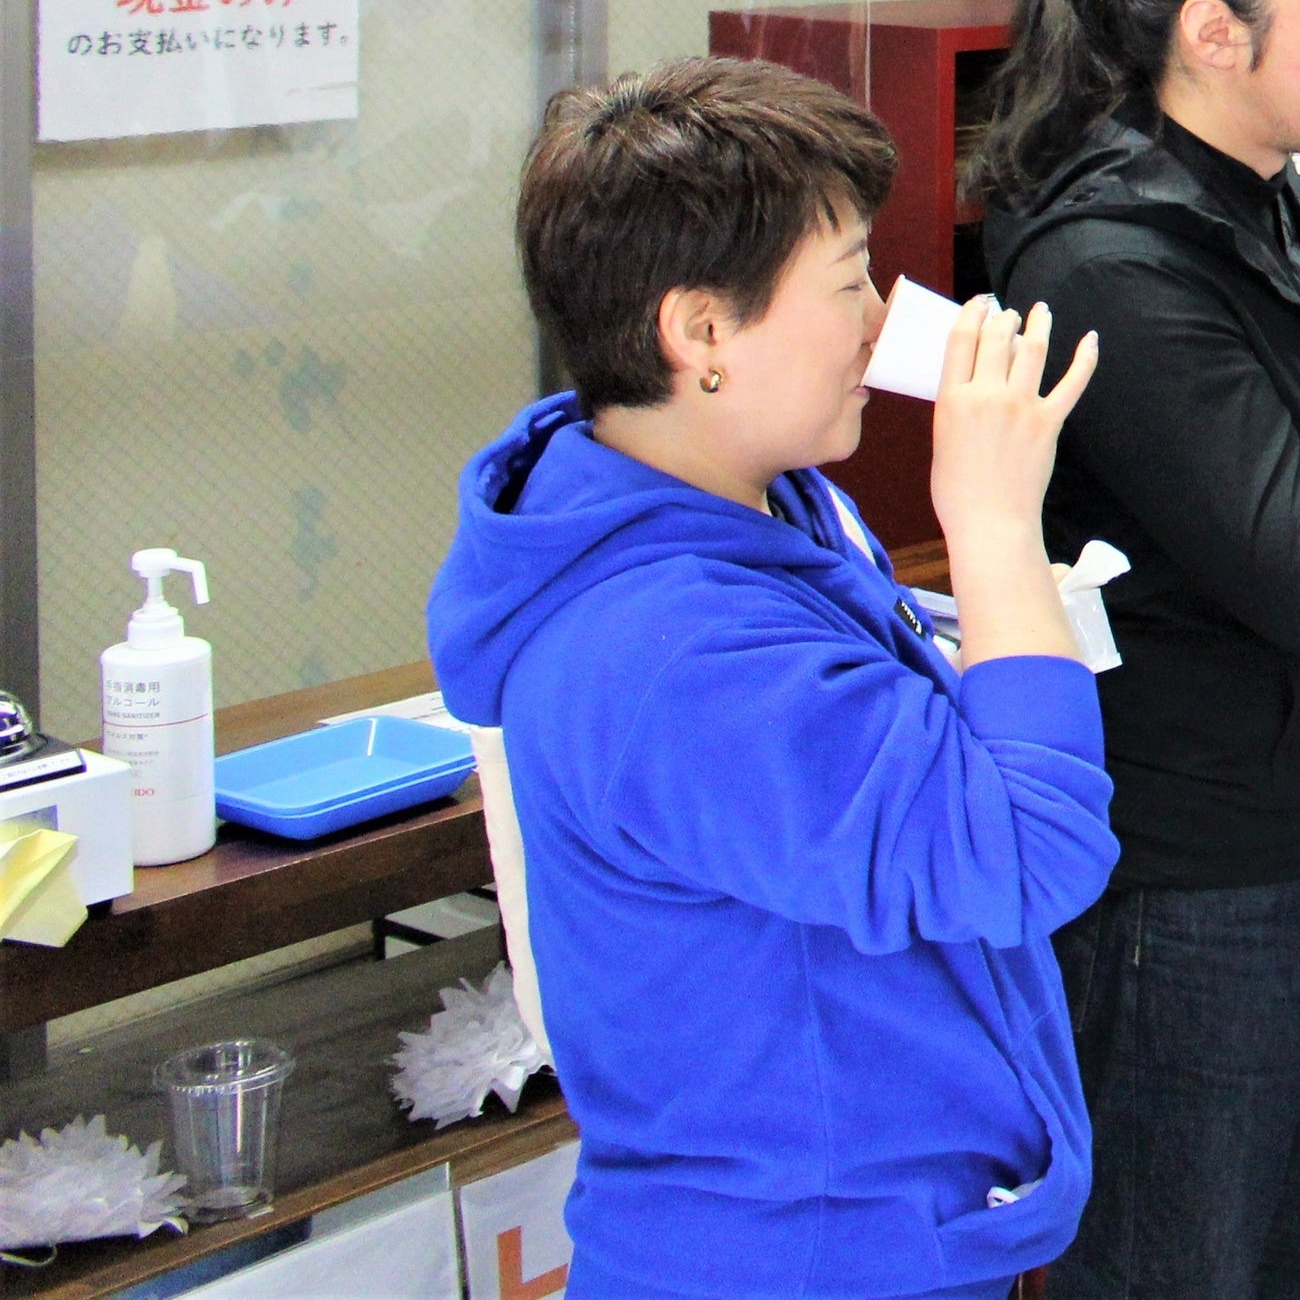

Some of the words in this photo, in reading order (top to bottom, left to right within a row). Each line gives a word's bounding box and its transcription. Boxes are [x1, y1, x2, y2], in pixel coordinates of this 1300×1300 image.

[67, 22, 349, 57] のお支払いになります。
